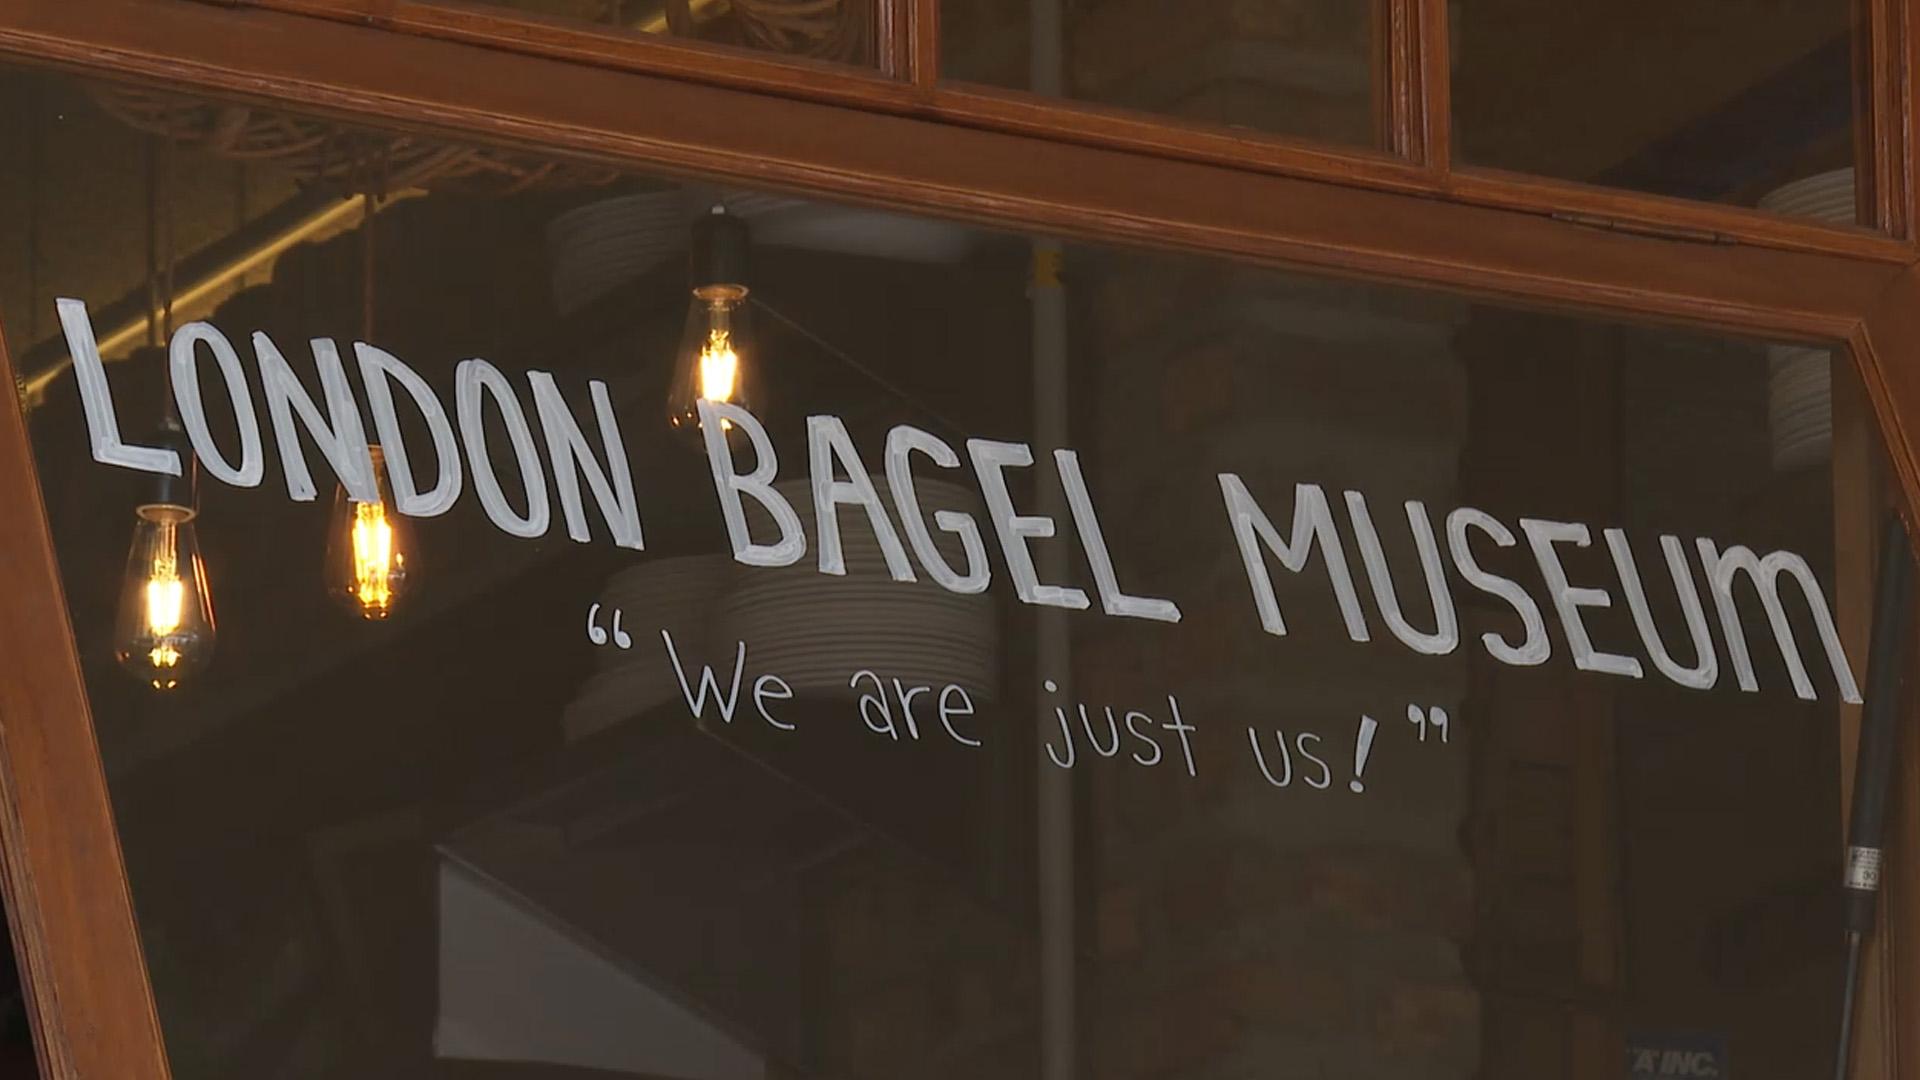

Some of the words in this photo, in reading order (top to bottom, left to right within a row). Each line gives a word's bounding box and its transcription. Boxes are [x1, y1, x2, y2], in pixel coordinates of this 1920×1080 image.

[57, 298, 643, 550] LONDON
[696, 399, 1181, 622] BAGEL
[850, 670, 982, 747] are
[1046, 680, 1196, 777] just
